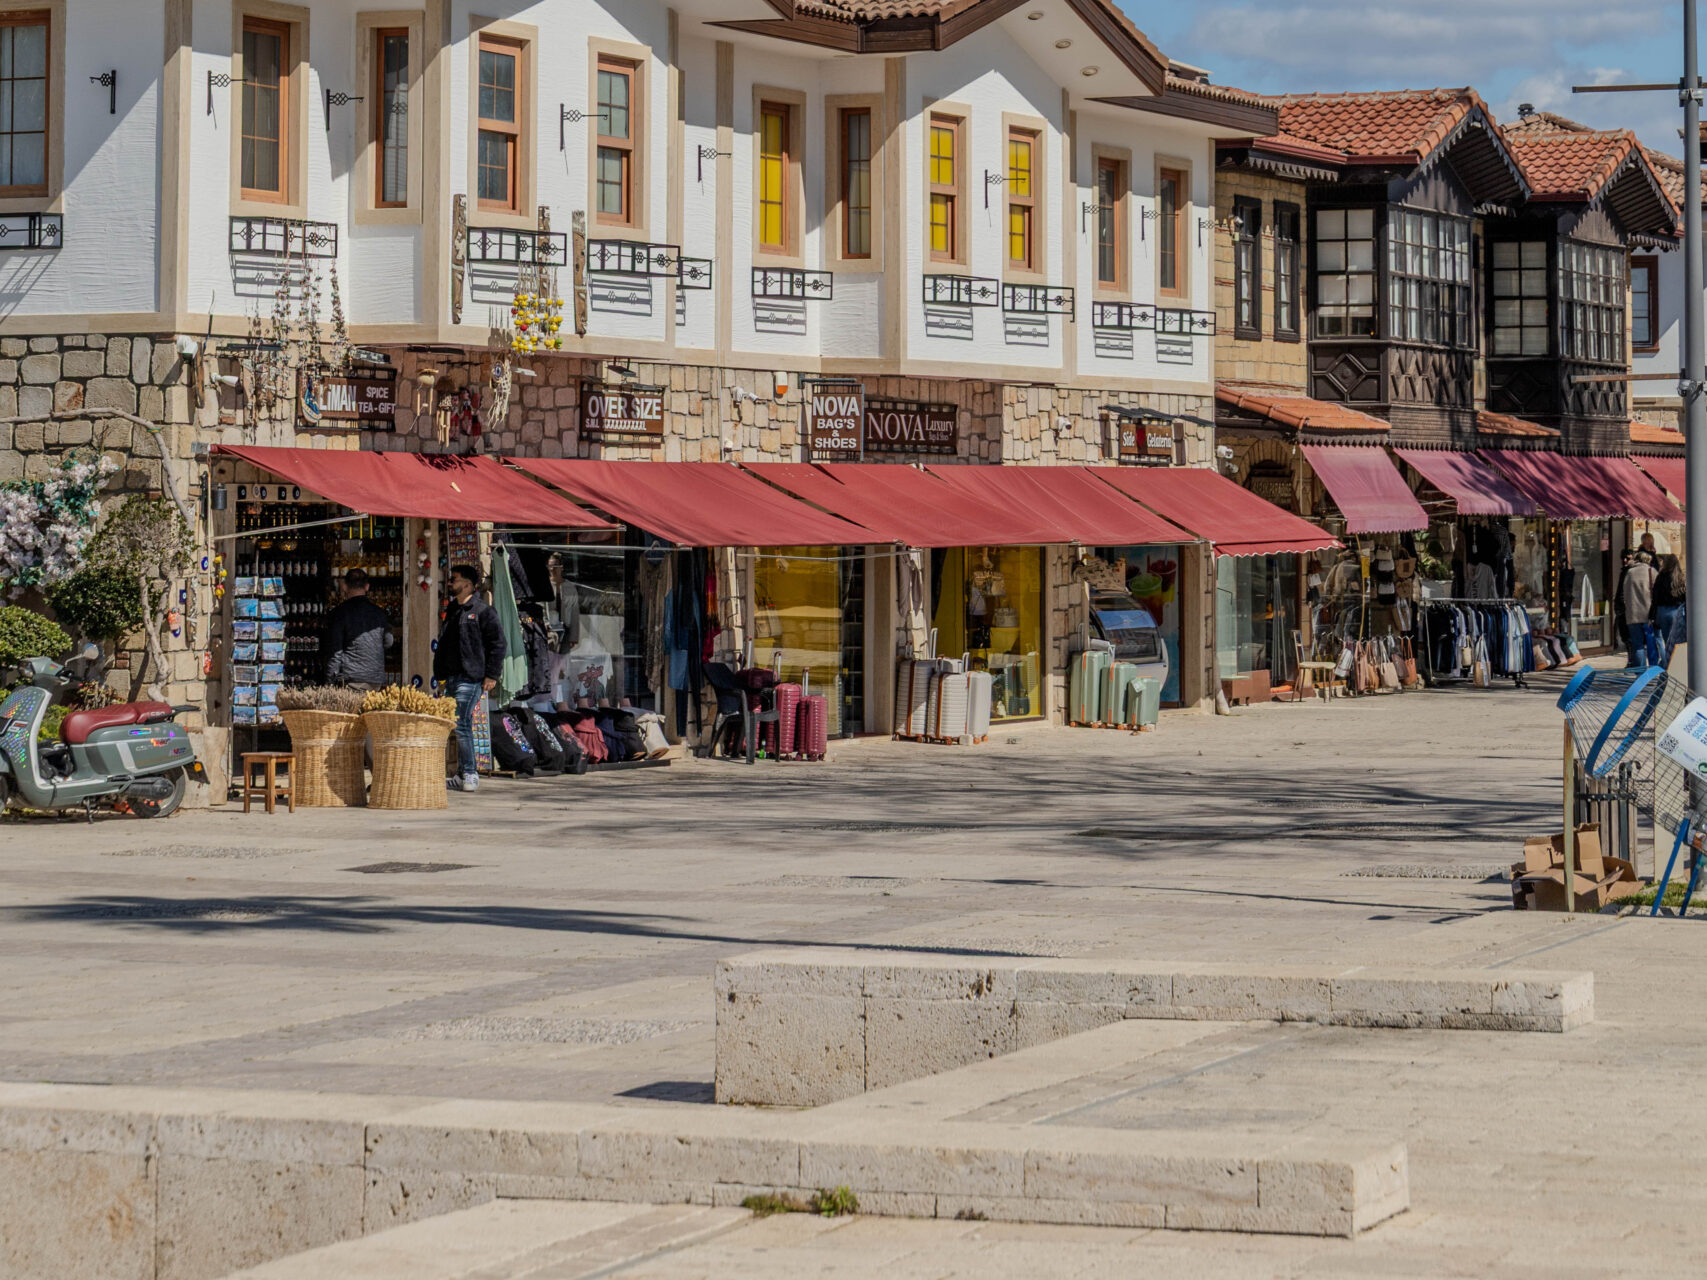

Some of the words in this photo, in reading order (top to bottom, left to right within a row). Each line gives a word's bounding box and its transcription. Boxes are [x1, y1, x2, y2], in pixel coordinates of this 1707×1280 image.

[366, 386, 389, 399] SPICE
[588, 395, 628, 419] OVER
[631, 397, 662, 420] SIZE
[812, 396, 860, 417] NOVA
[817, 418, 856, 429] BAG'S
[866, 412, 926, 441] NOVA
[925, 414, 954, 436] Luxury
[831, 429, 840, 437] &
[1122, 431, 1136, 447] Side
[1146, 432, 1172, 448] Gelateria
[815, 437, 857, 449] SHOES
